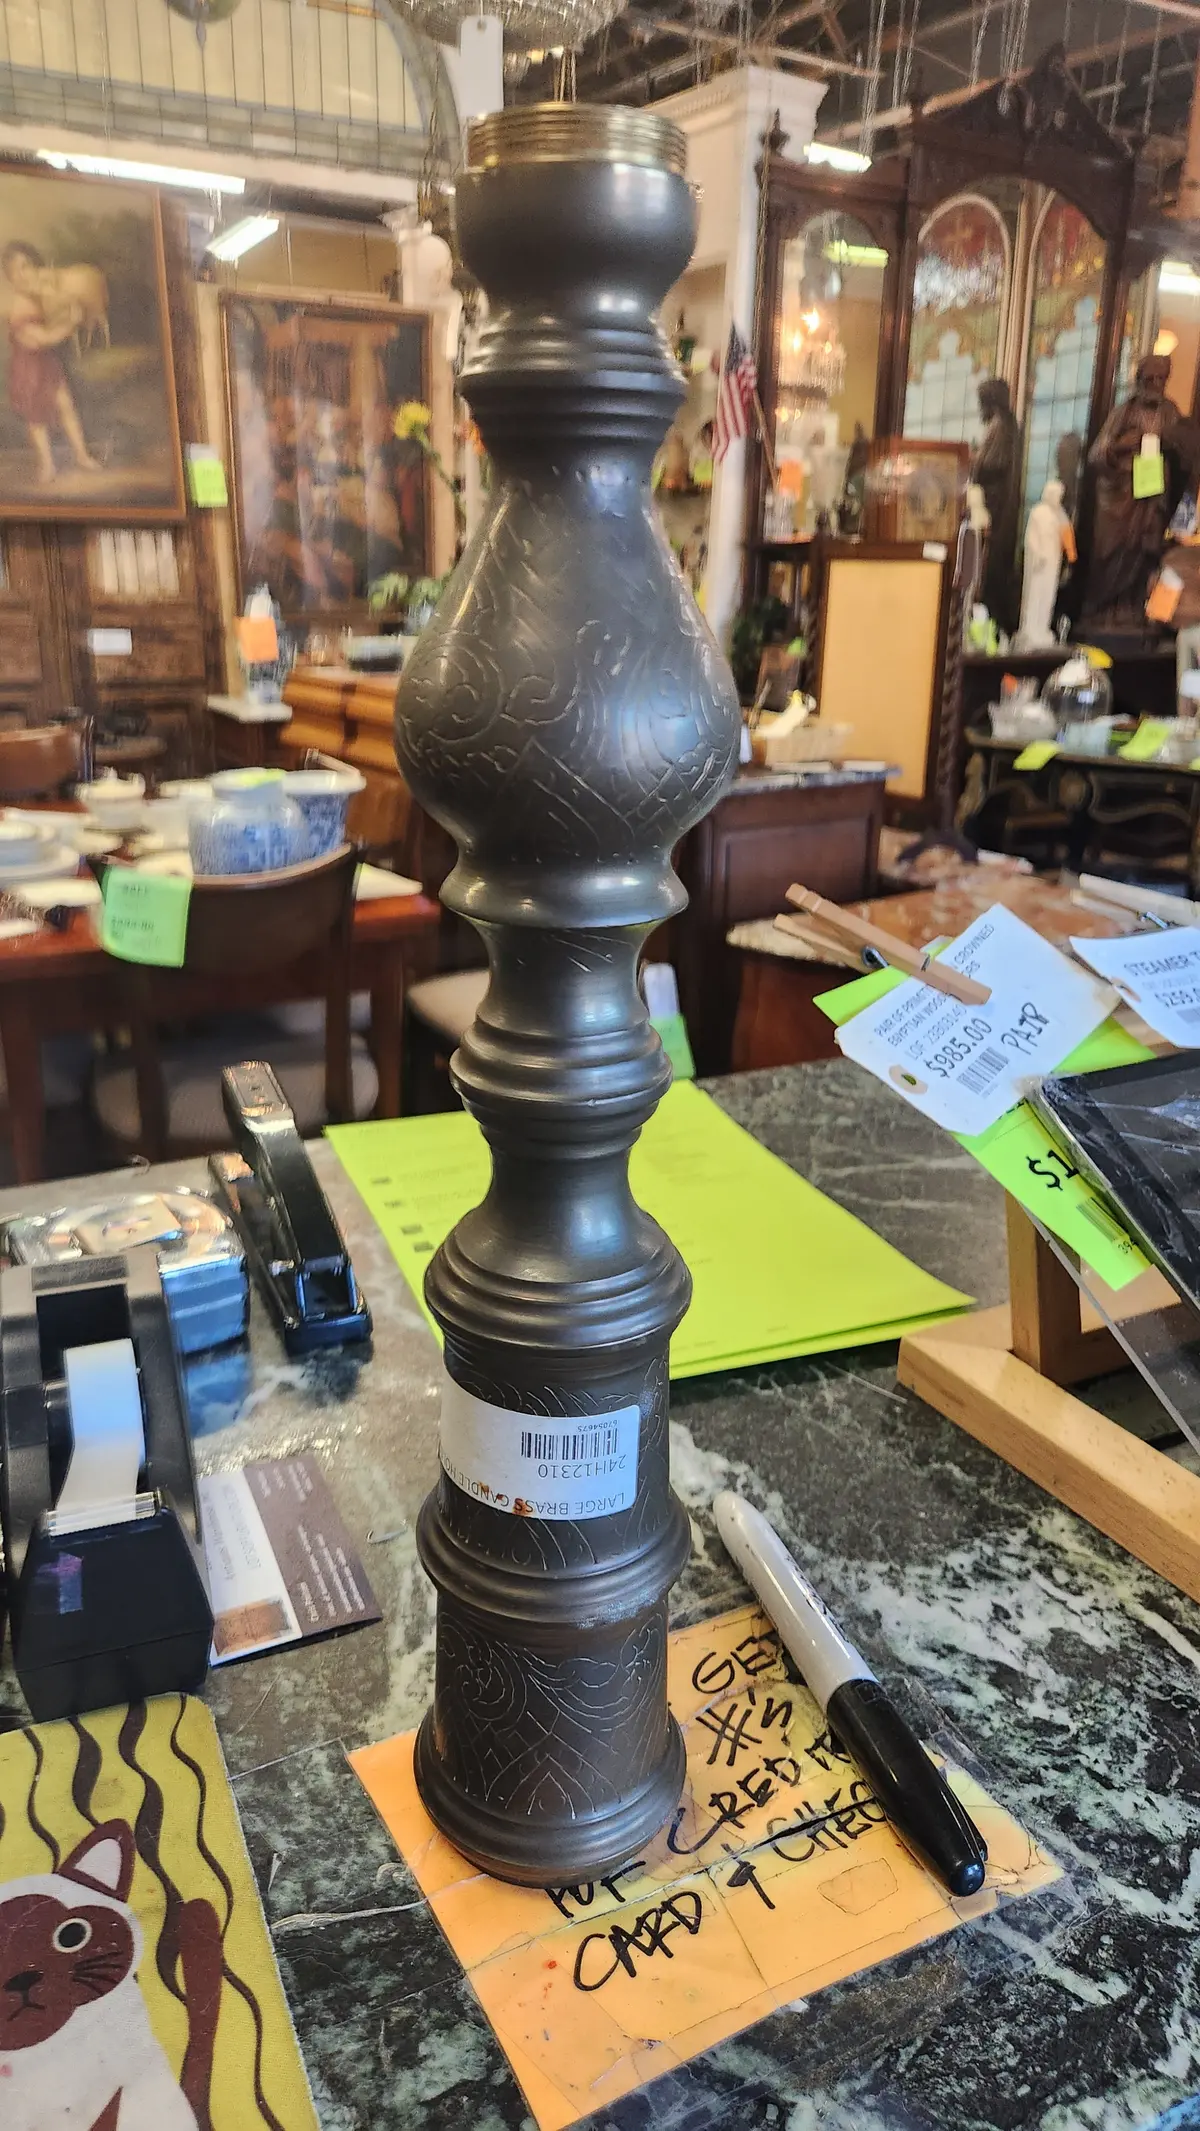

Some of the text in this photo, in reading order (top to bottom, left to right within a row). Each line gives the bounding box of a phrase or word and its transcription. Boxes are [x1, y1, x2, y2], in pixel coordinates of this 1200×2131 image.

[873, 1019, 896, 1038] PAIR
[890, 1007, 905, 1023] OF
[953, 923, 995, 965] CROWNED
[1123, 955, 1193, 977] STEAMER
[887, 1013, 926, 1047] EGYPTIAN
[1001, 1001, 1049, 1056] PAIR
[924, 1017, 992, 1078] $985.00
[538, 1454, 626, 1479] 24H12310
[459, 1471, 510, 1507] CANDLE
[514, 1497, 569, 1516] BRASS
[574, 1492, 625, 1516] LARGE
[573, 1890, 702, 1992] CARD
[766, 1779, 886, 1862] CHEC
